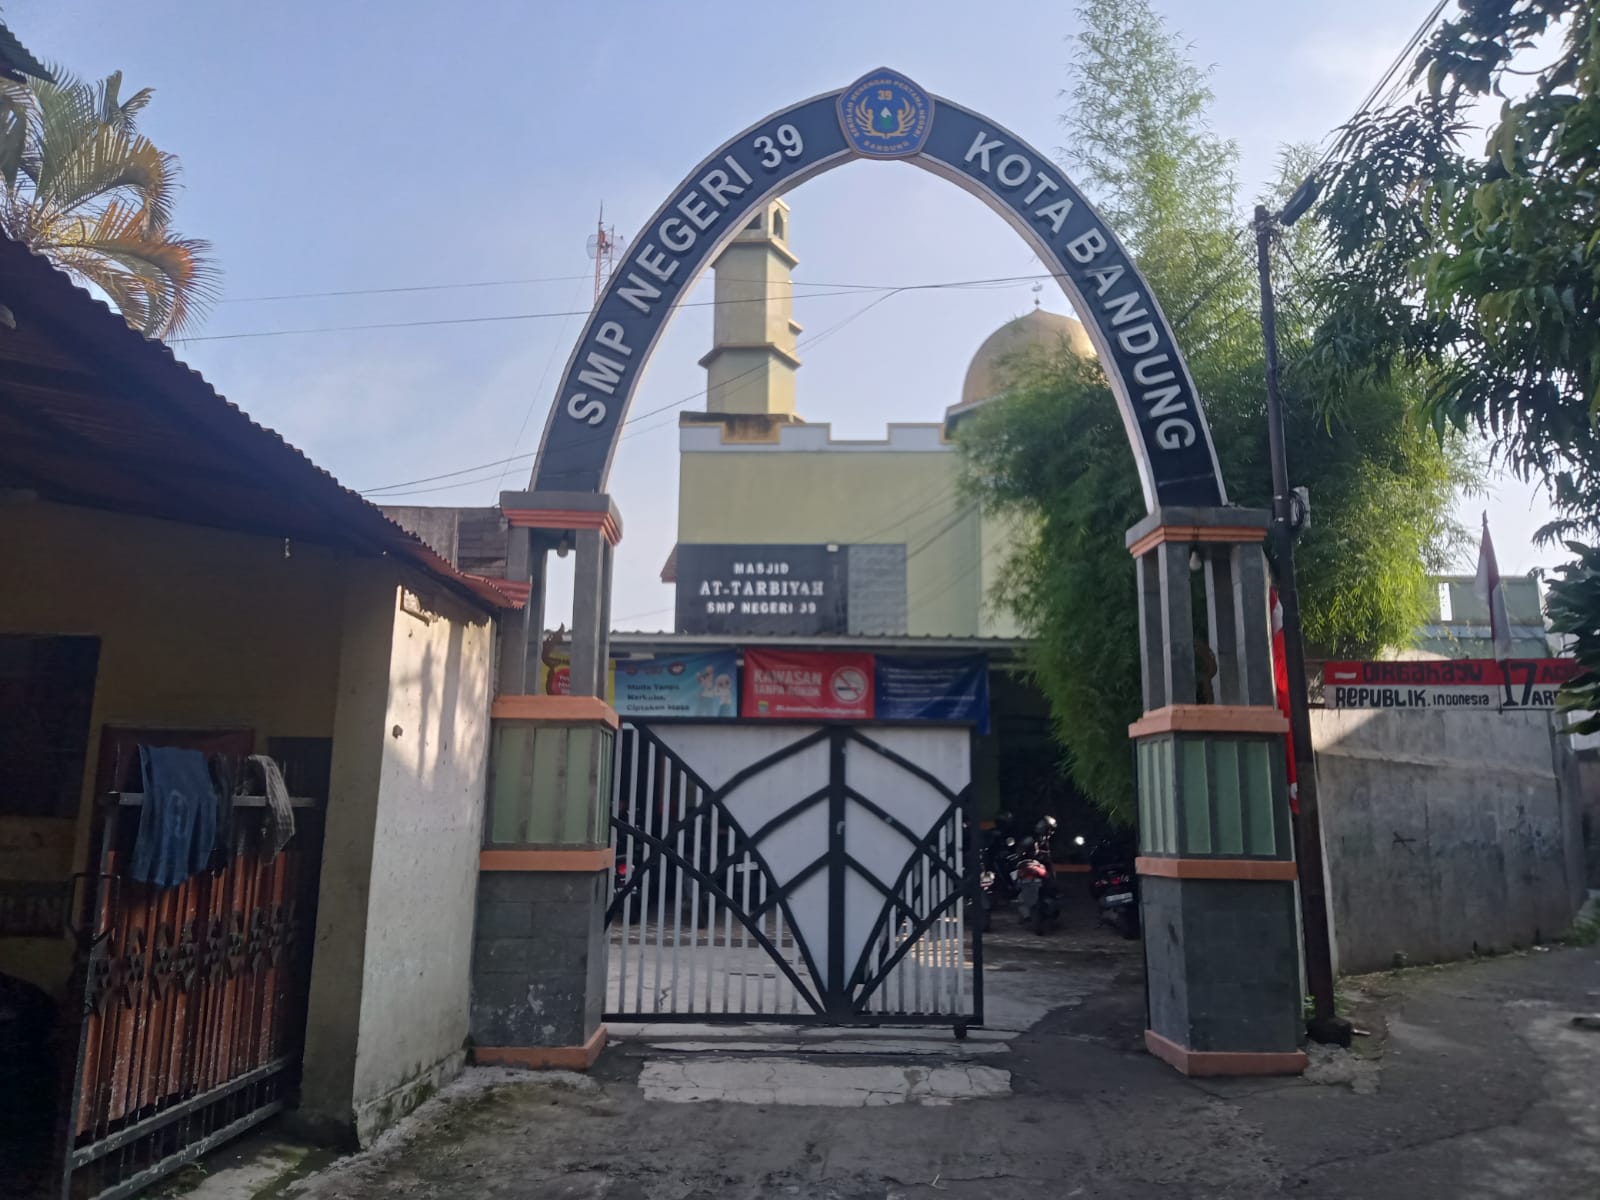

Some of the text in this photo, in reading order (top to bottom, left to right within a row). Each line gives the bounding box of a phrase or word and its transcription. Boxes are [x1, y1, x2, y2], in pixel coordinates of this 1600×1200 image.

[567, 123, 803, 426] SMP NEGERI 39
[964, 131, 1196, 450] KOTA BANDUNG
[733, 562, 789, 575] MASJID
[699, 580, 824, 596] AT-TARBIYAH
[706, 602, 817, 614] SMP NEGERI 39
[753, 669, 822, 685] KAWASAN
[1501, 661, 1537, 706] 17
